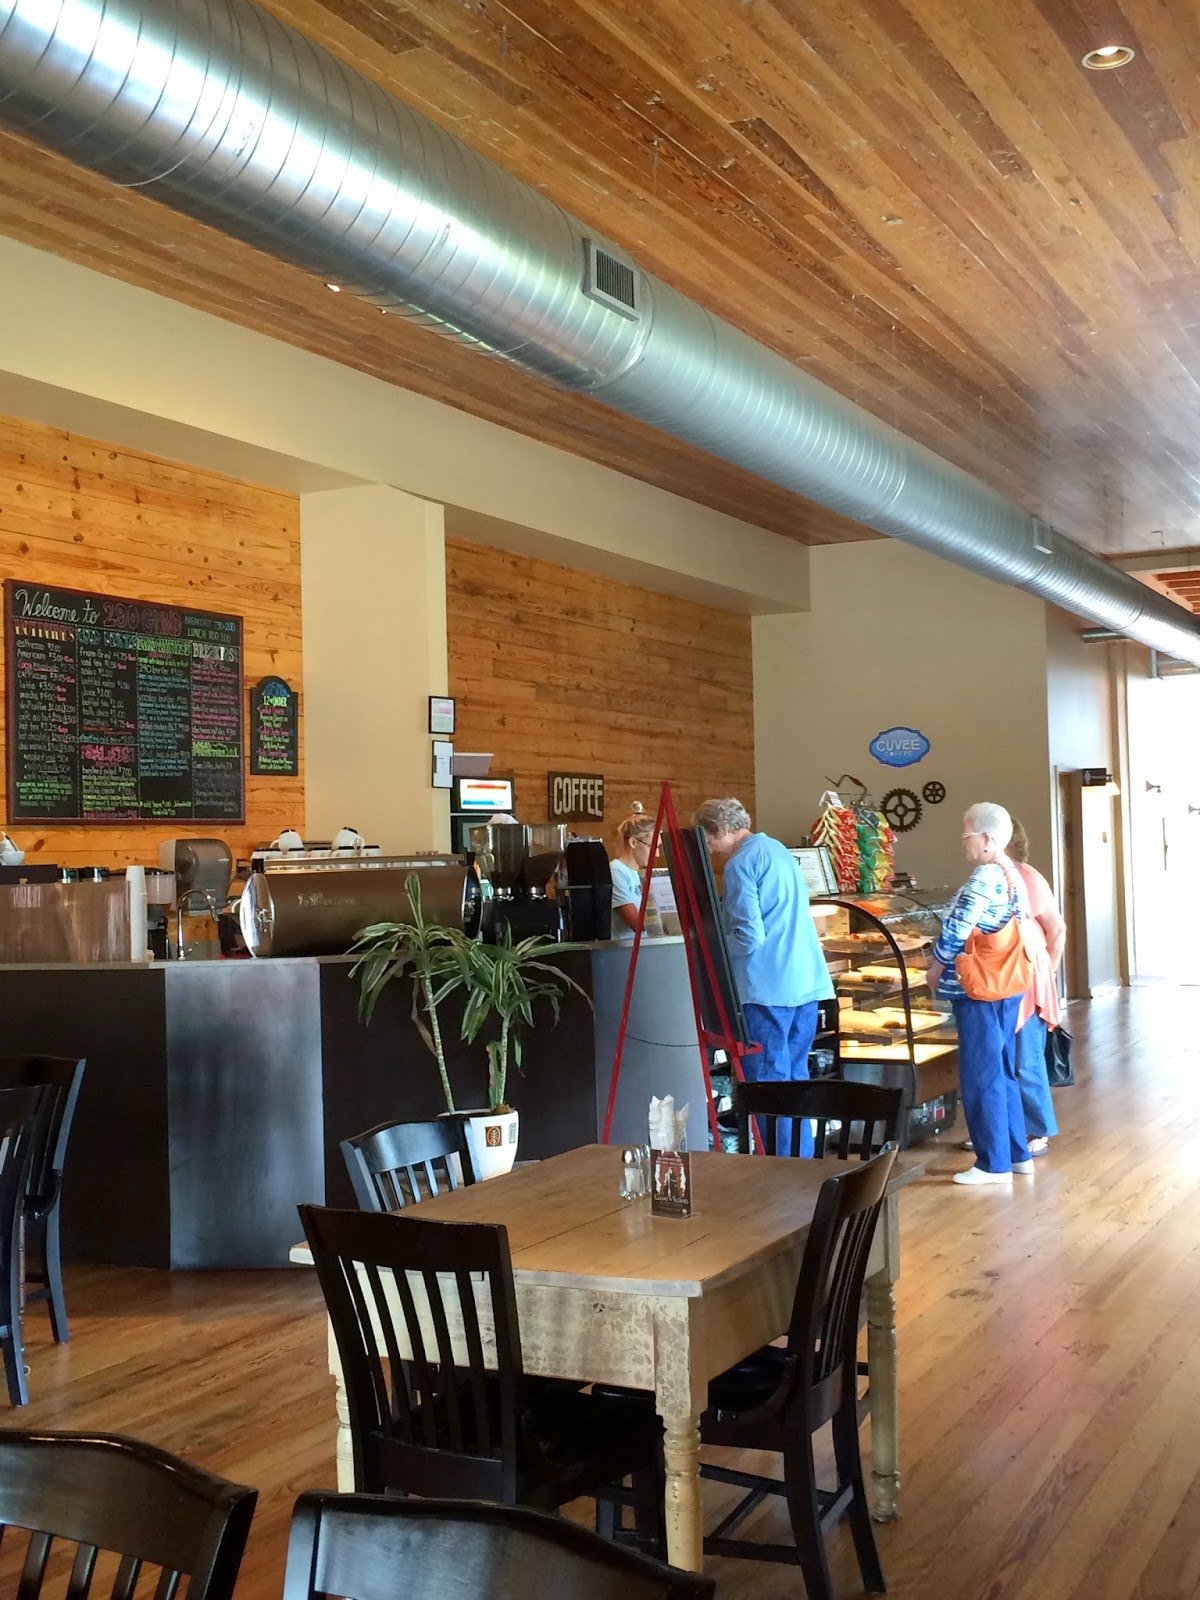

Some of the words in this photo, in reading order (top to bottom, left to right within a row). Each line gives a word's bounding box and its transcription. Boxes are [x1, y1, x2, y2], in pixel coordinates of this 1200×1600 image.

[15, 589, 80, 622] Welcome
[82, 599, 100, 624] to
[103, 602, 139, 630] 290
[876, 739, 920, 751] CUVEE
[553, 776, 603, 817] COFFEE
